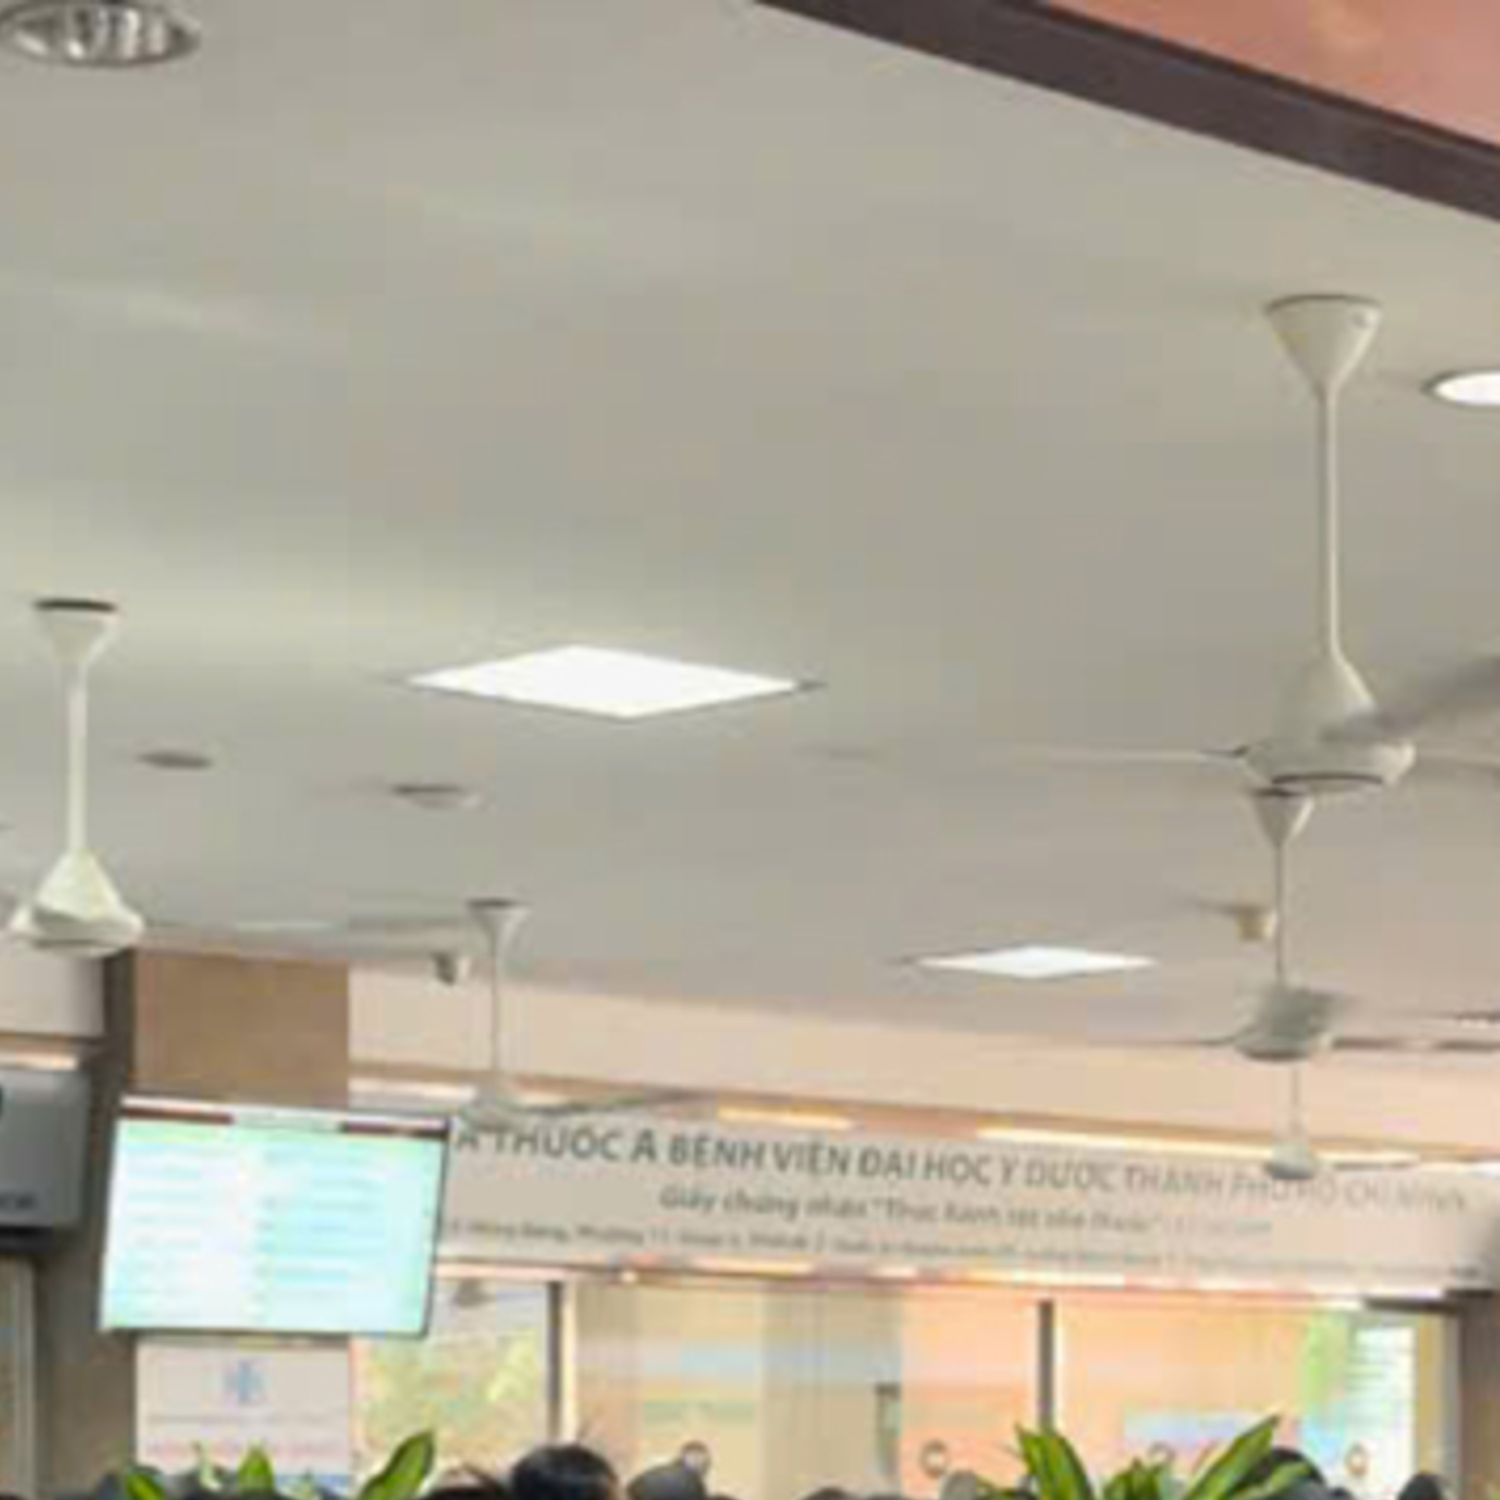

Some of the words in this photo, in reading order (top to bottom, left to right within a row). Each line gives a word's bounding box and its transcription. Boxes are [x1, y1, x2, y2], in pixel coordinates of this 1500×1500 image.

[773, 1139, 850, 1177] VIỆN
[858, 1146, 916, 1183] ĐẠI
[923, 1151, 991, 1188] HỌC
[1000, 1155, 1020, 1187] Y
